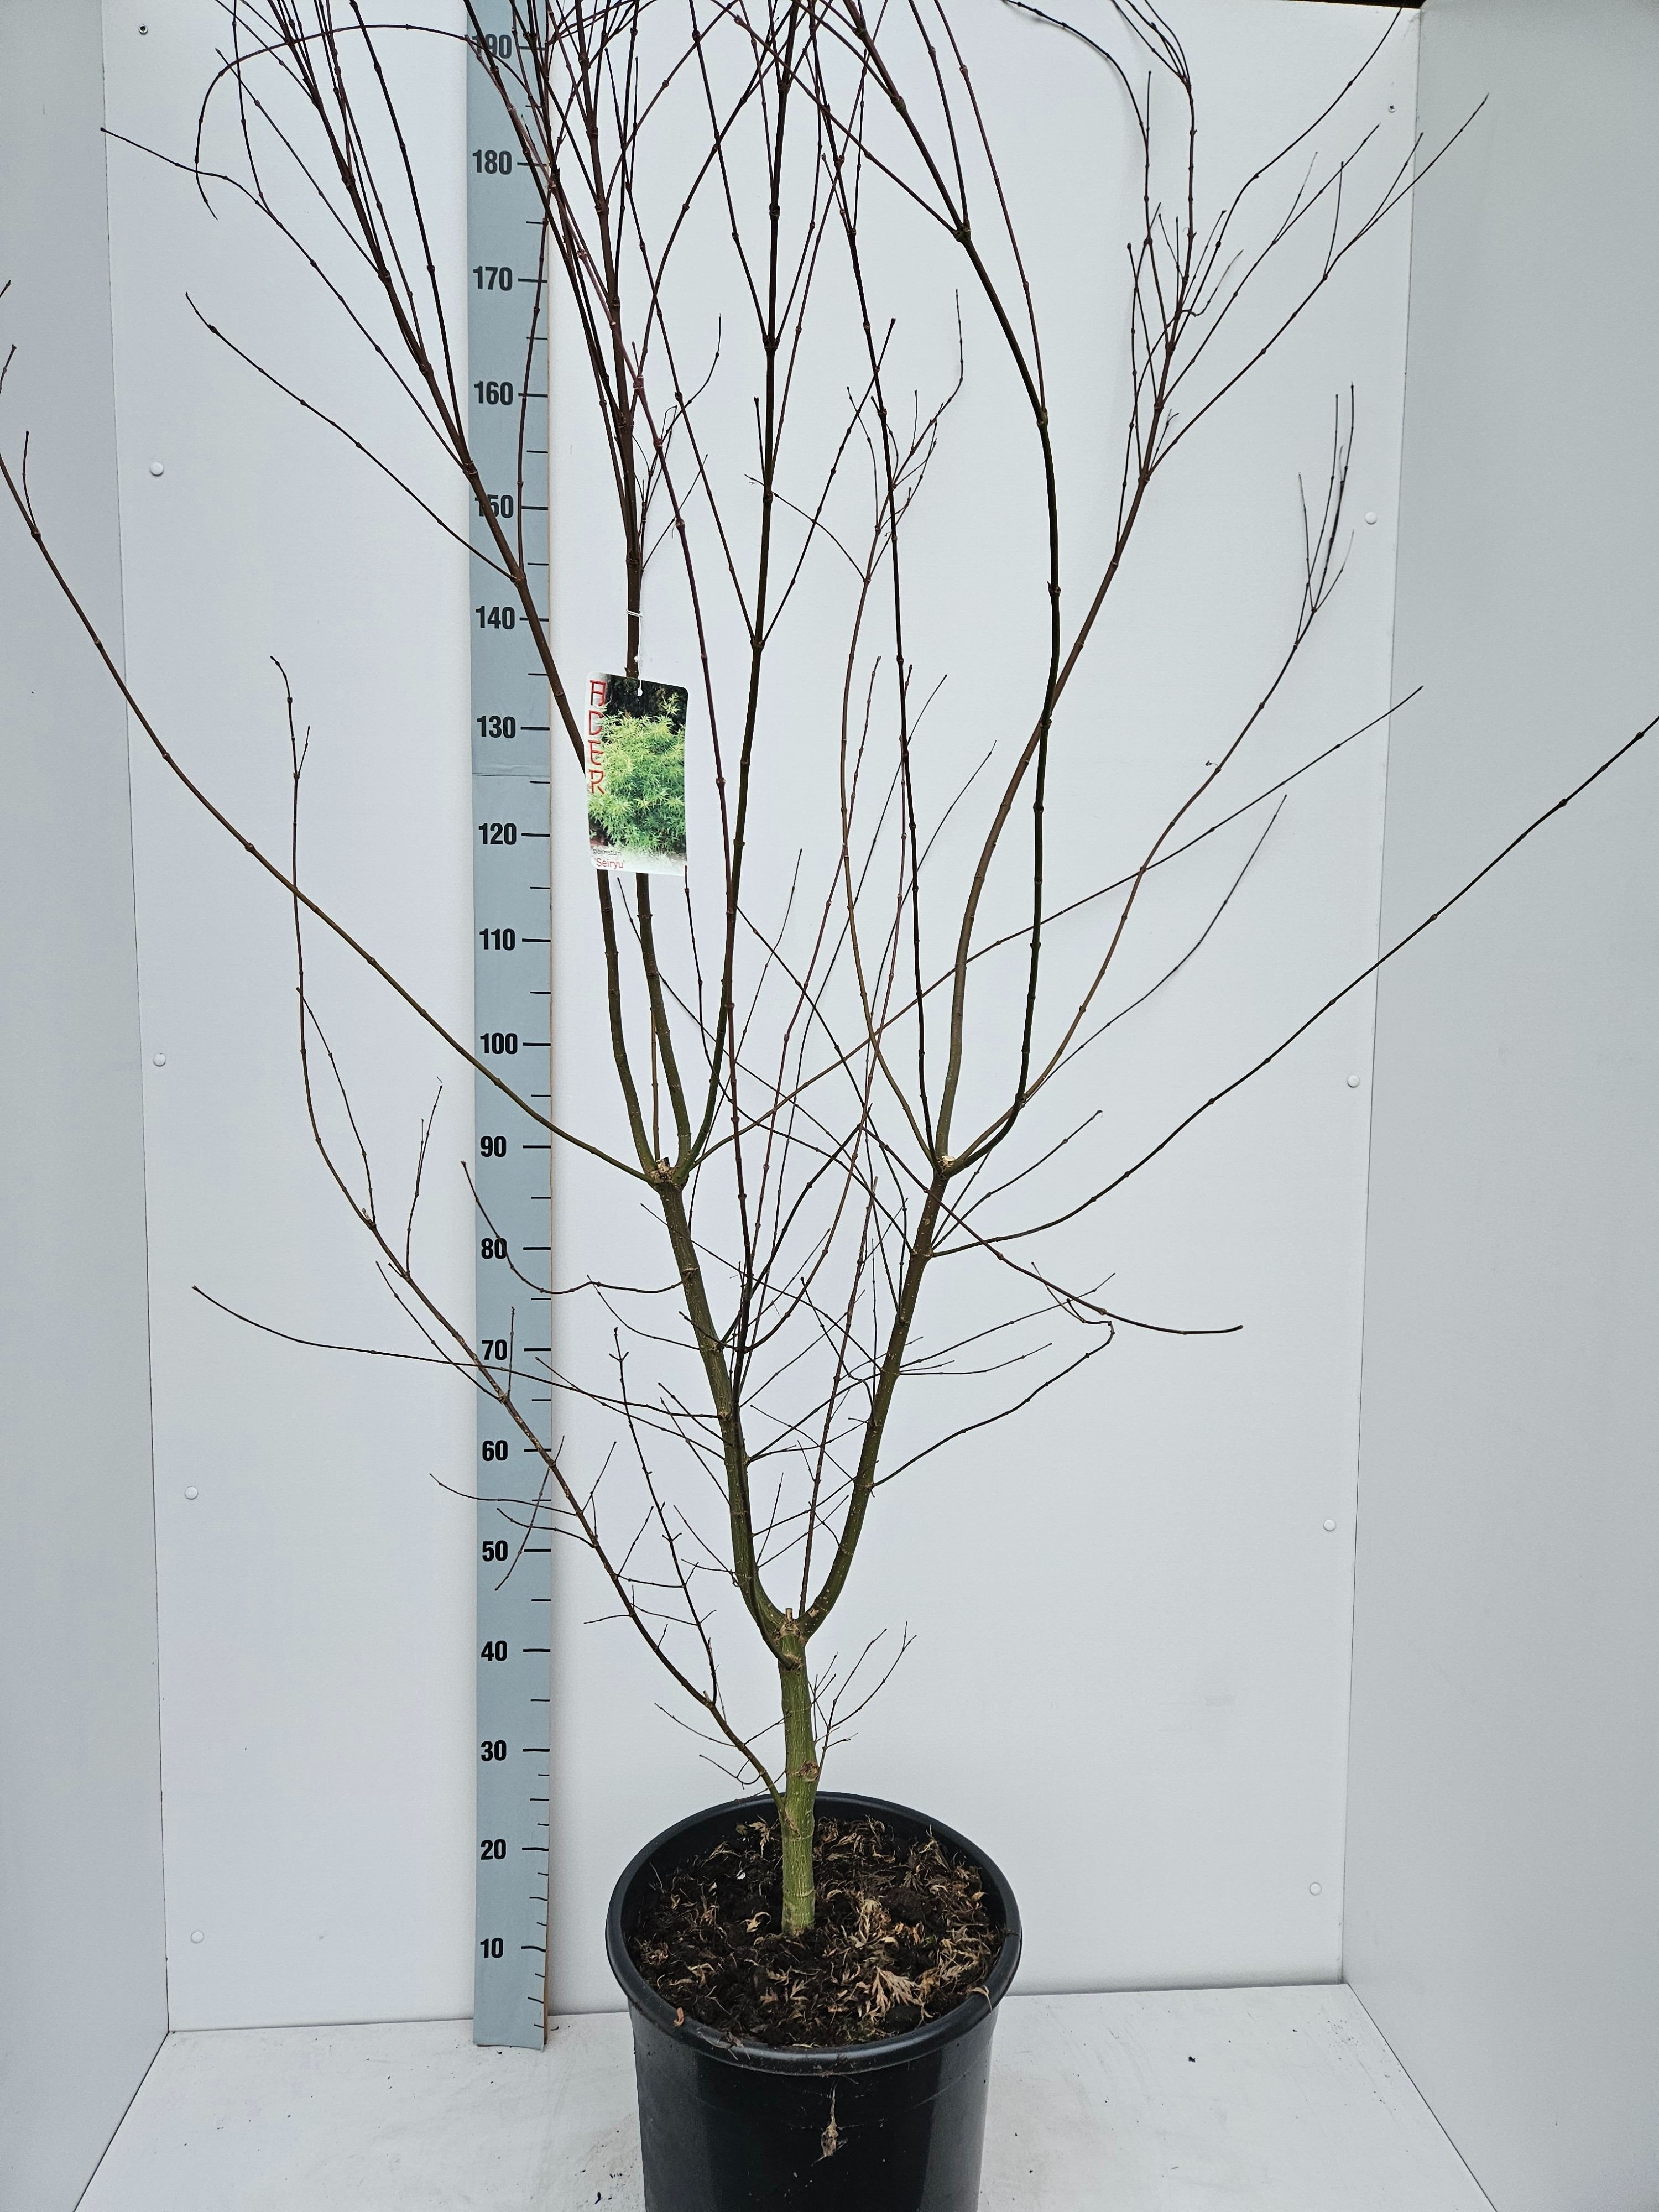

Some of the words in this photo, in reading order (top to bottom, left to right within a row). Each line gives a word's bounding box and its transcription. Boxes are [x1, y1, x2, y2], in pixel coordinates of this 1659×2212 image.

[472, 34, 512, 59] 190
[473, 149, 512, 175] 180
[473, 266, 513, 291] 170
[474, 380, 514, 405] 160
[474, 494, 514, 518] 150
[476, 606, 515, 629] 140
[477, 715, 516, 738] 130
[588, 680, 606, 795] ACER
[478, 822, 517, 845] 120
[479, 928, 515, 951] 110
[480, 1032, 518, 1055] 100
[480, 1135, 507, 1157] 90
[481, 1238, 507, 1259] 80
[482, 1339, 508, 1360] 70
[482, 1440, 508, 1461] 60
[482, 1540, 508, 1562] 50
[481, 1640, 508, 1661] 40
[481, 1740, 507, 1761] 30
[481, 1839, 506, 1860] 20
[480, 1937, 504, 1959] 10
